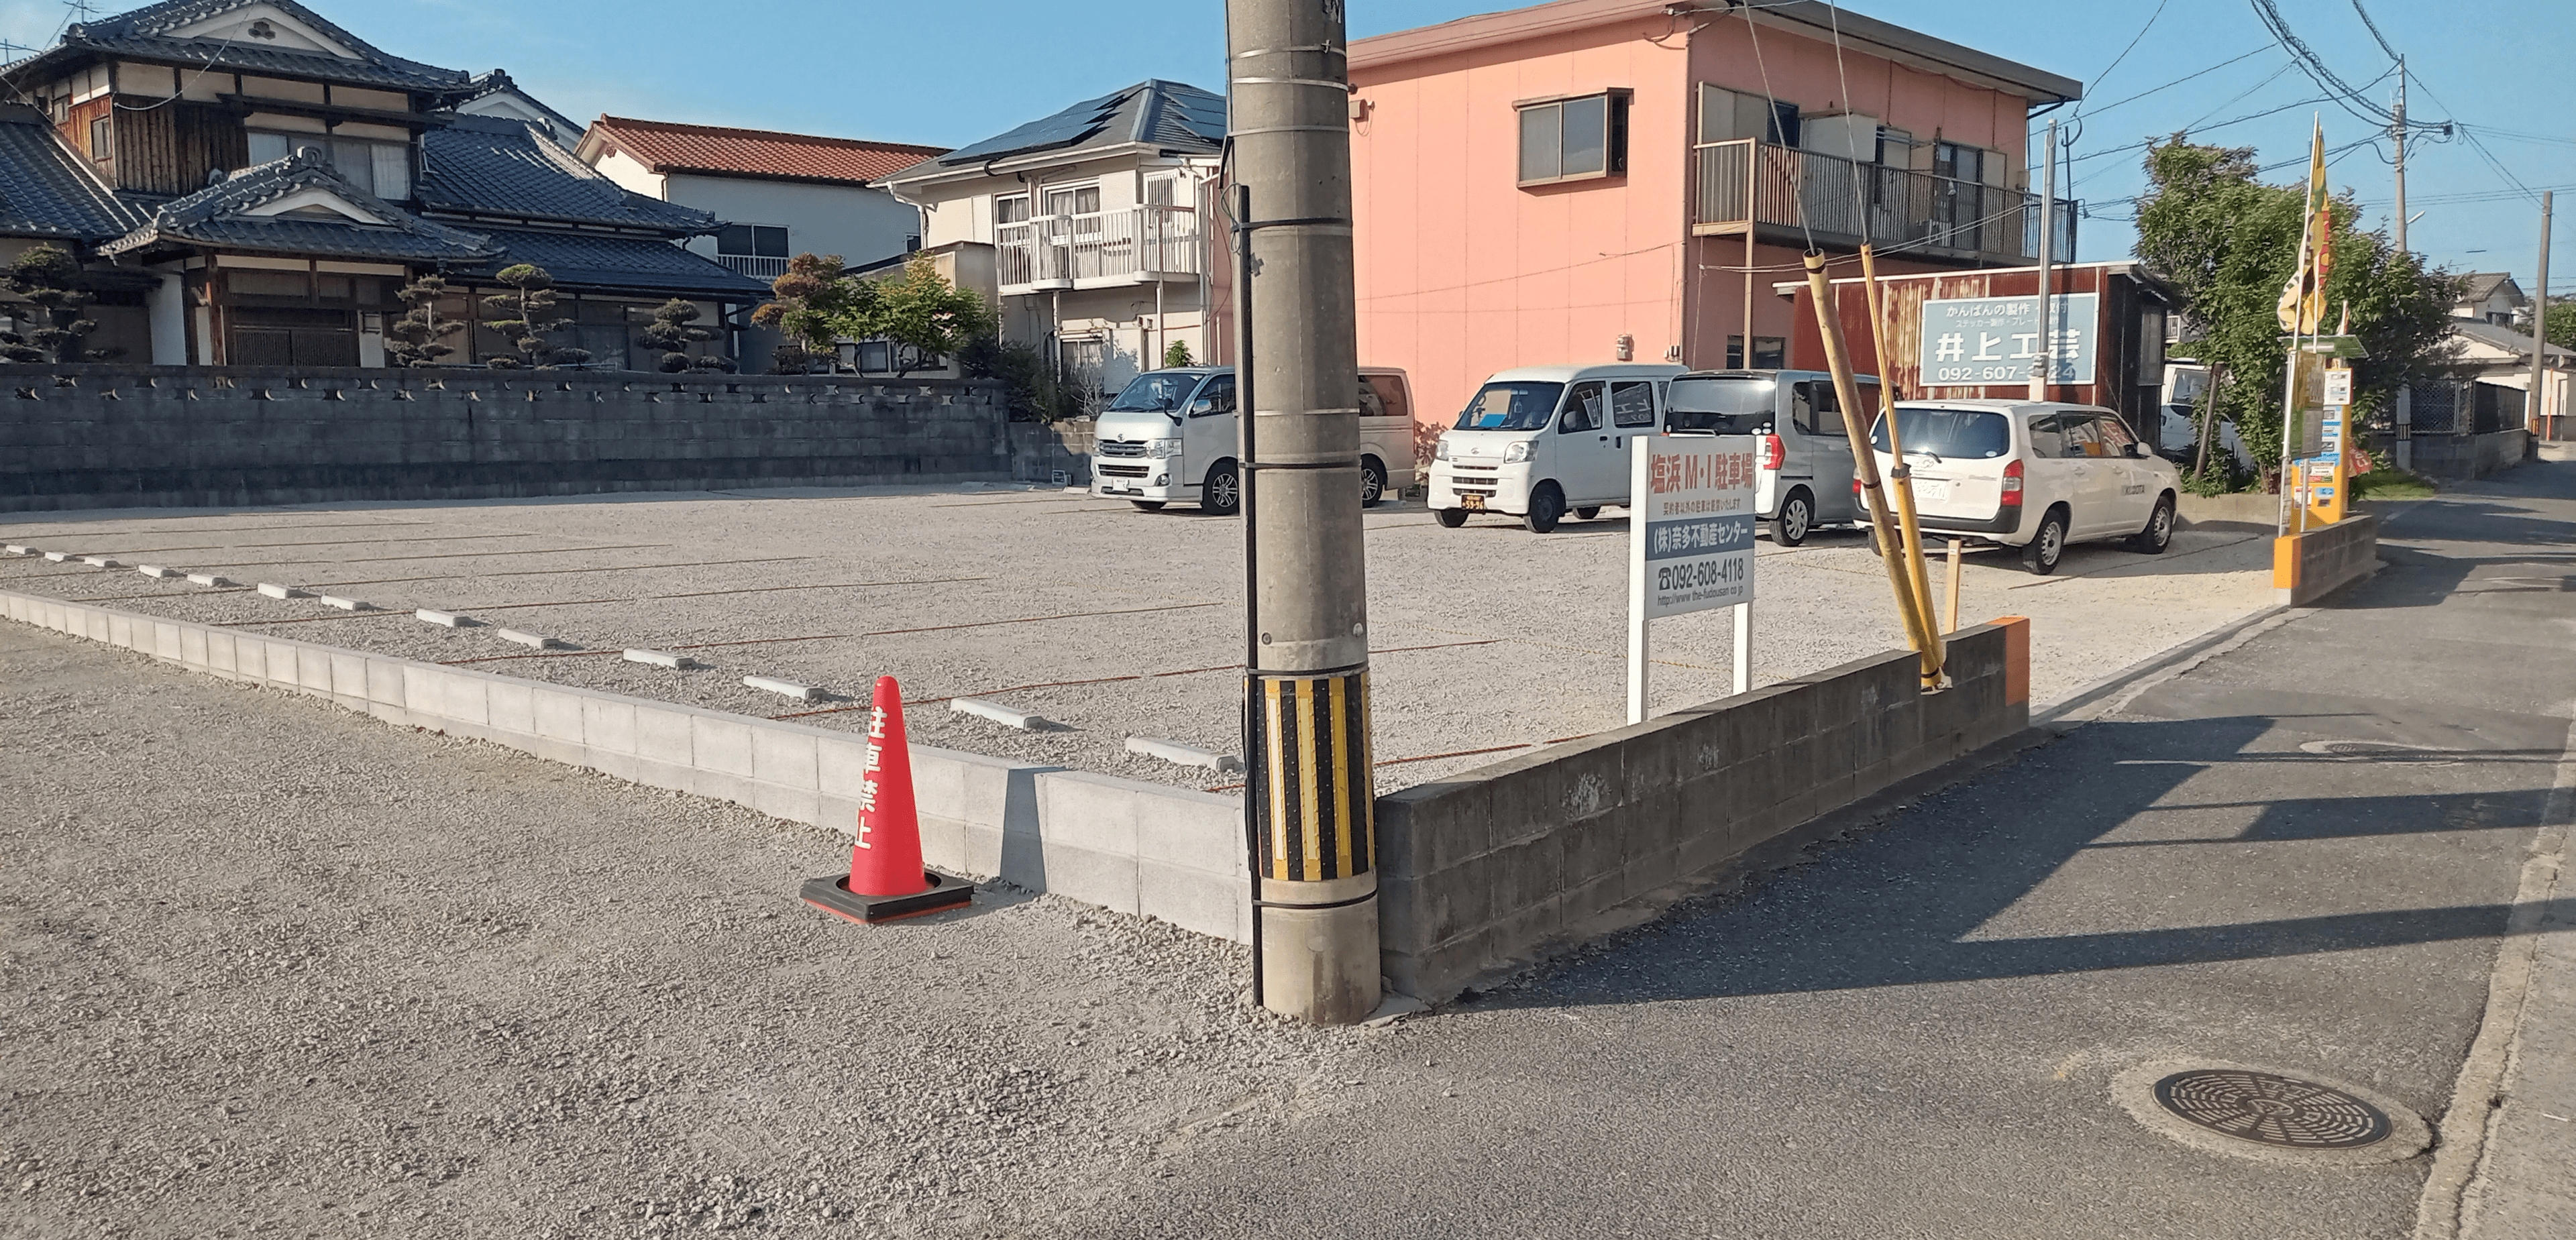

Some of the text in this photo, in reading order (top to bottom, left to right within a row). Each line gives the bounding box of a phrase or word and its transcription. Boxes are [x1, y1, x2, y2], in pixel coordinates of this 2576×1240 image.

[1935, 328, 2081, 363] 井上工芸
[1654, 520, 1748, 554] (株)奈多不動産センター
[1672, 557, 1743, 590] 092-608-4118
